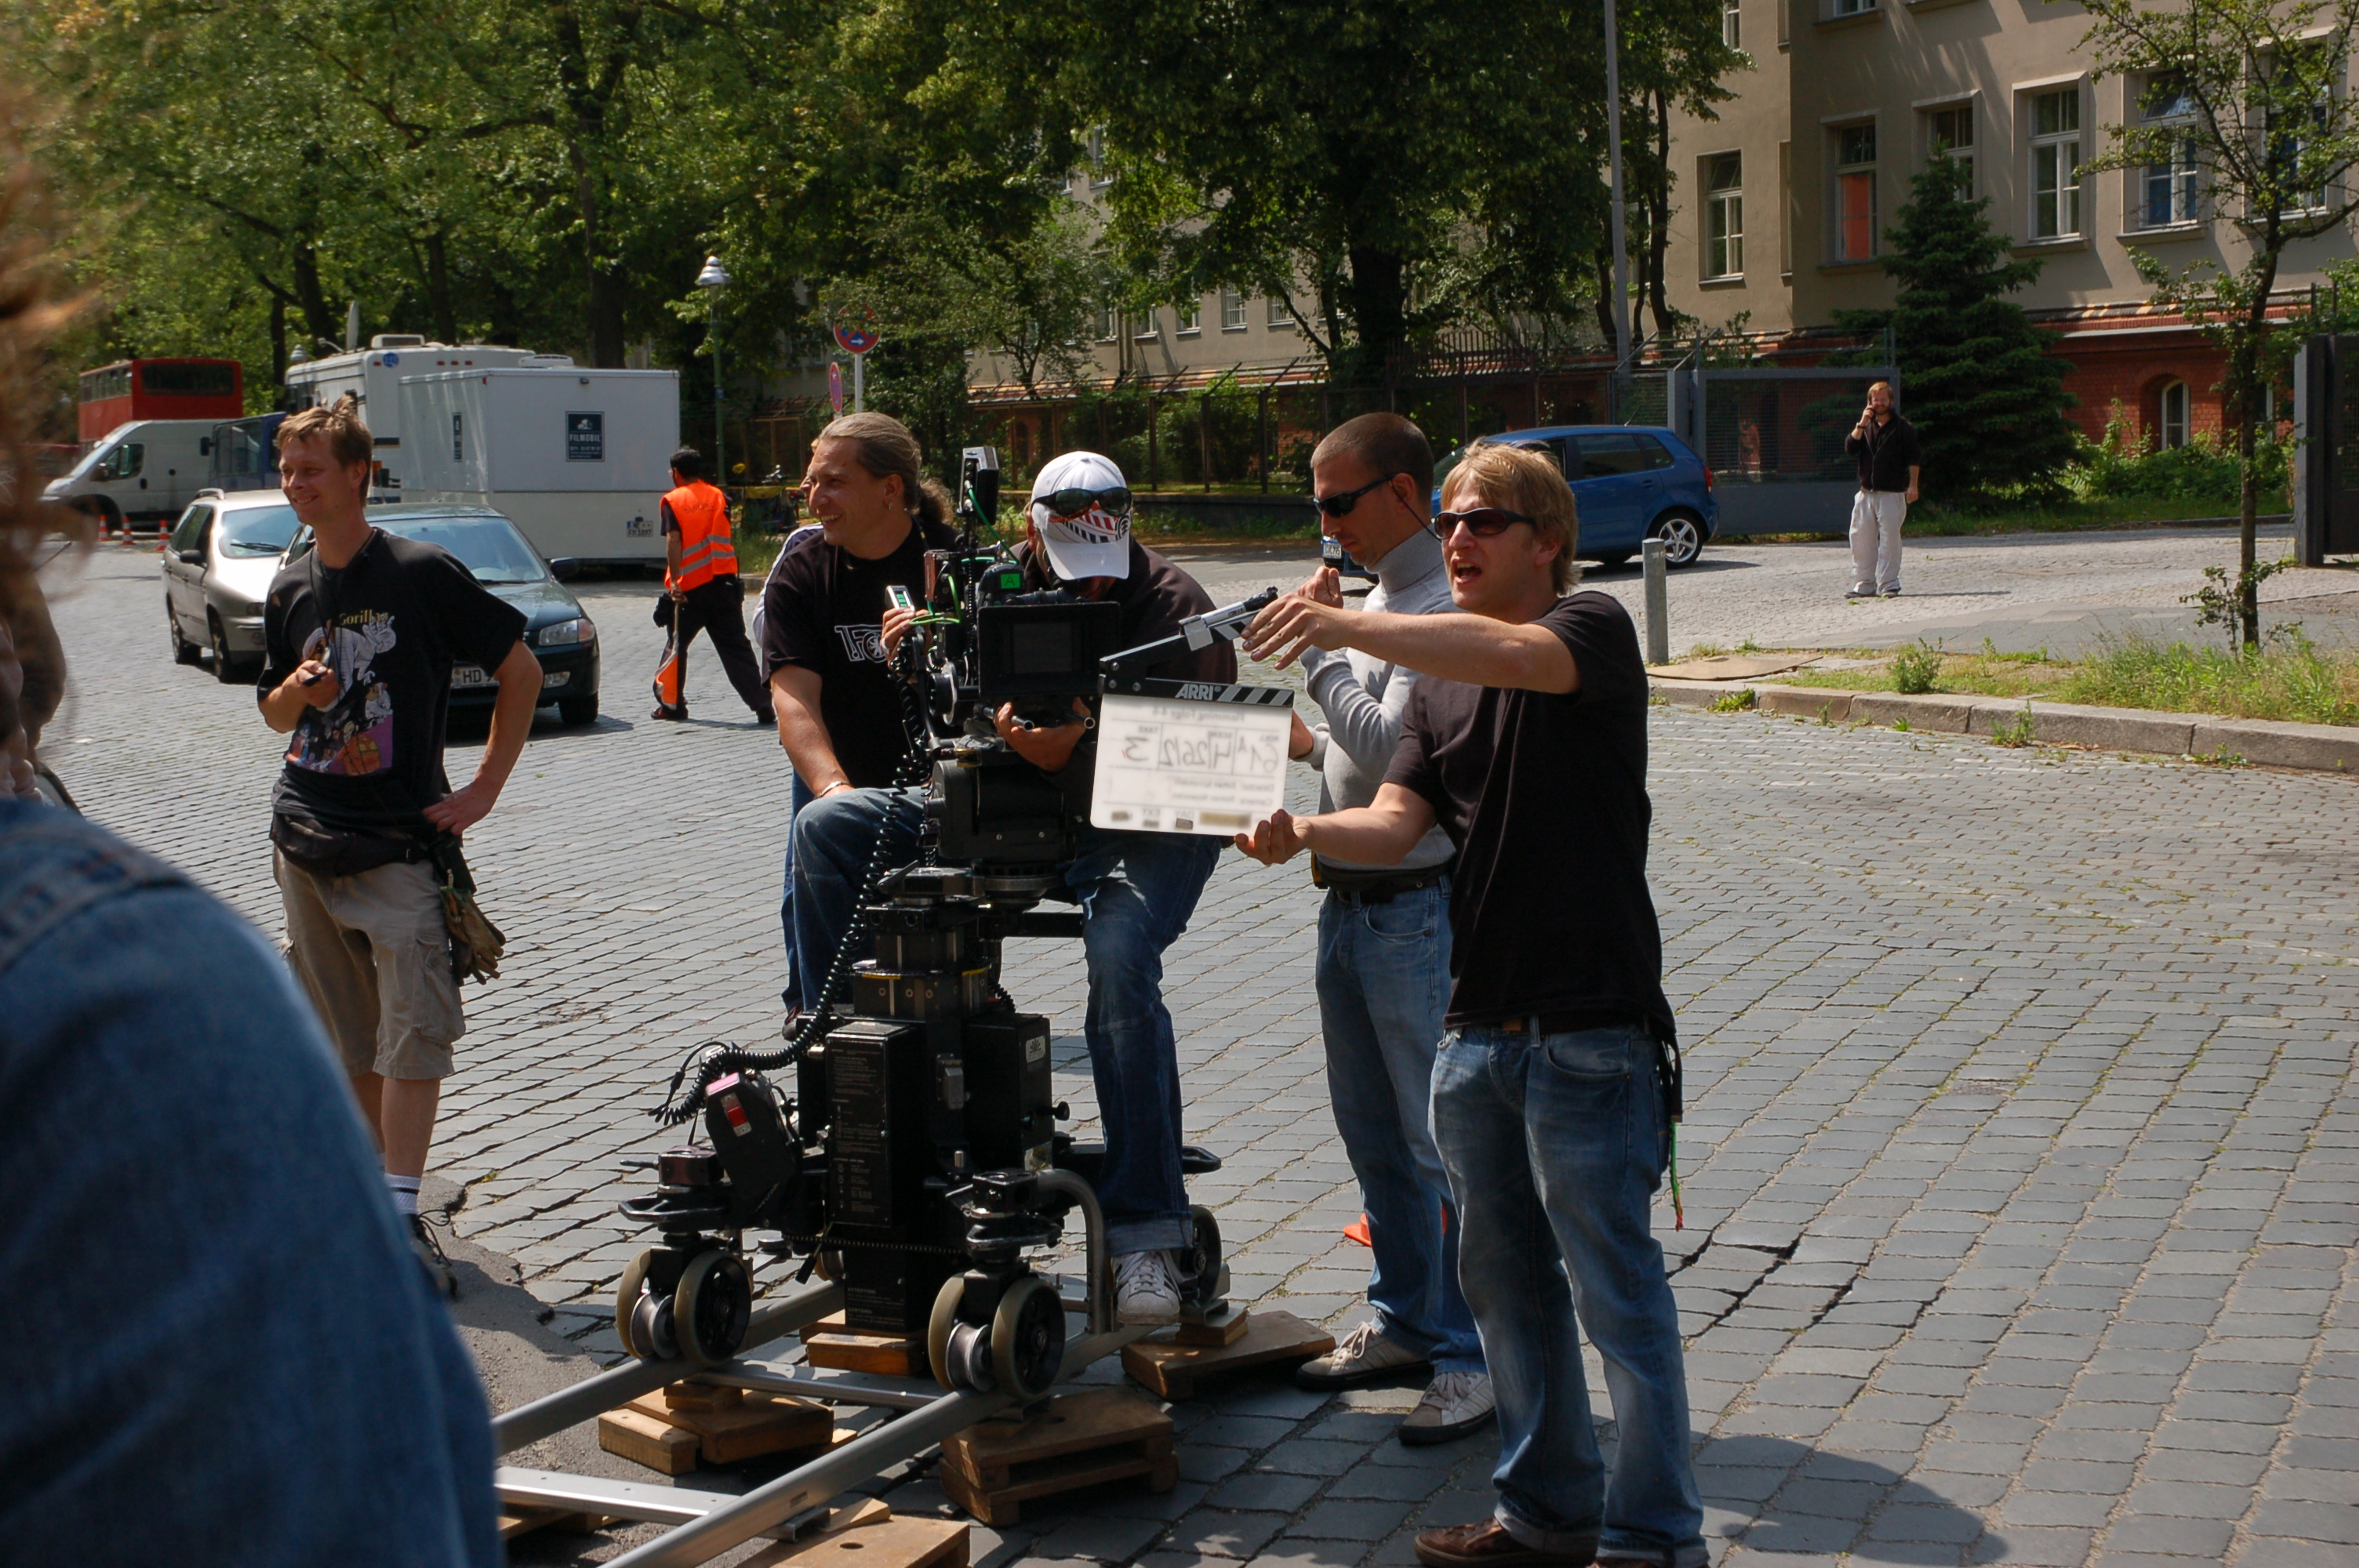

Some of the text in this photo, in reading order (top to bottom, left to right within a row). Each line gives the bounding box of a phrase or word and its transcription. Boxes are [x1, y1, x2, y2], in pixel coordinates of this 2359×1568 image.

[569, 434, 601, 442] FILMOBIL
[1005, 575, 1016, 586] A
[463, 670, 482, 683] HD
